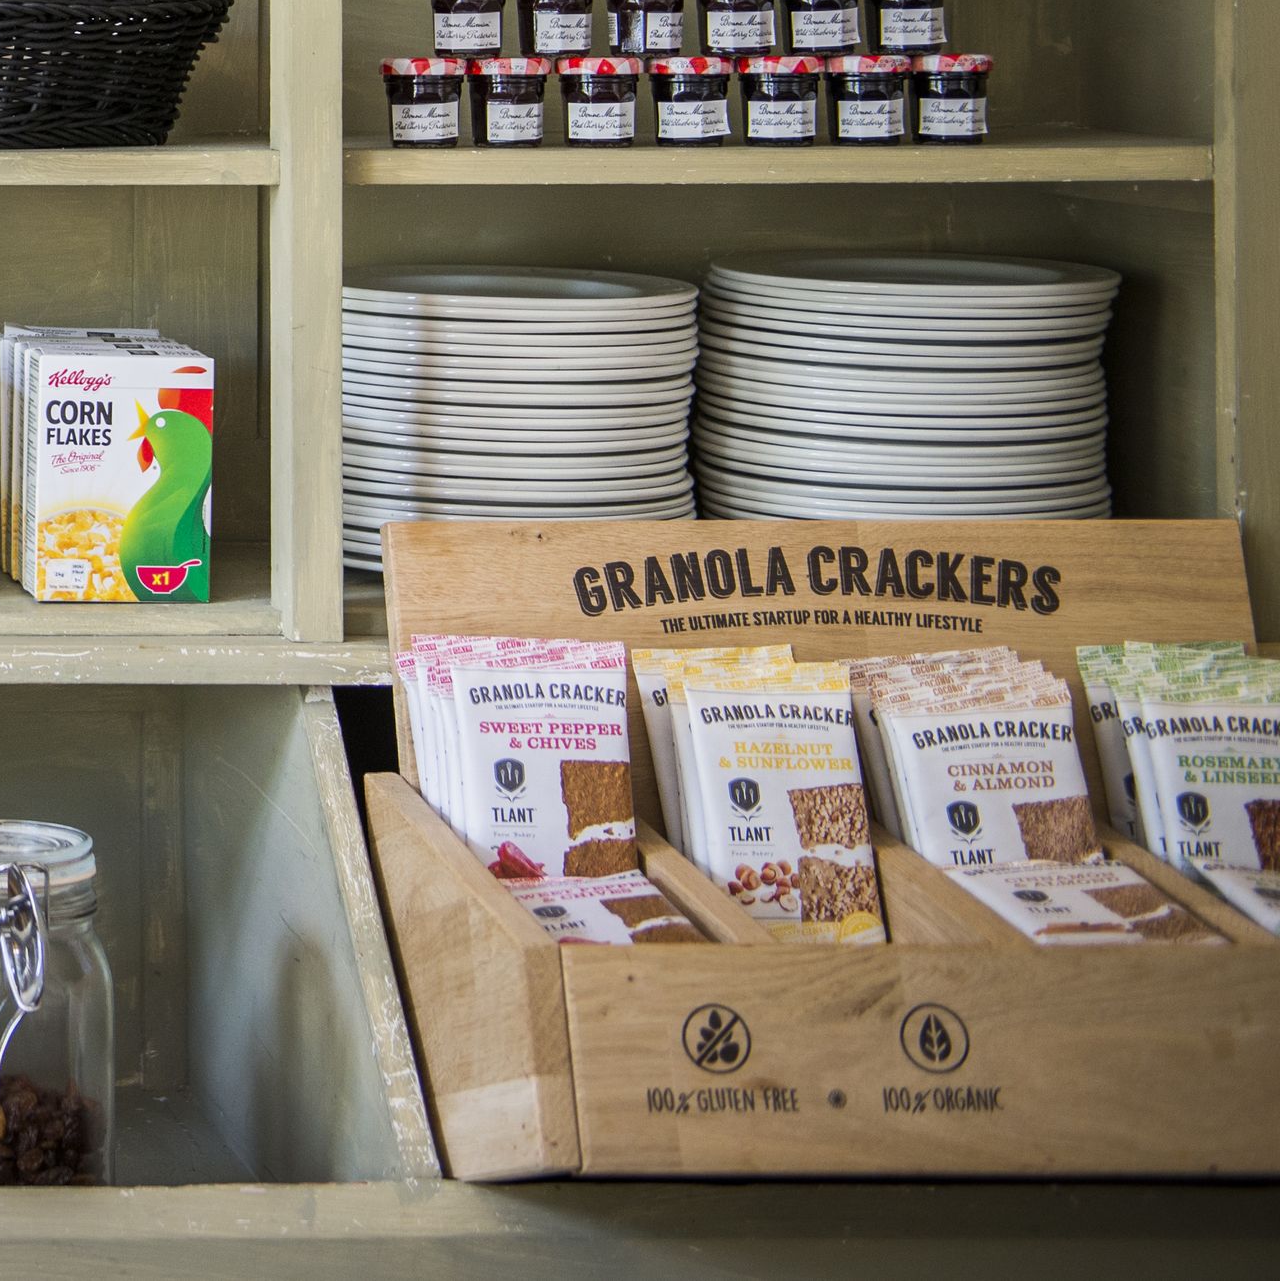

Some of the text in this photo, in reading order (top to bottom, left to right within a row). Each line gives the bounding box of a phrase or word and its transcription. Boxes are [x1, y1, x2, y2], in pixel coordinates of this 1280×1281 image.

[48, 368, 112, 392] Kellogg's
[45, 400, 113, 426] CORN
[46, 428, 112, 446] FLAKES
[51, 450, 105, 466] The Original
[151, 571, 170, 586] x1
[572, 545, 1062, 617] GRANOLA CRACKERS
[660, 610, 983, 634] THE ULTIMATE STARTUP FOR A HEALTHY LIFESTYLE
[469, 682, 545, 705] GRANOLA
[550, 682, 626, 708] CRACKER
[700, 703, 774, 726] GRANOLA
[780, 704, 855, 728] CRACKER
[480, 721, 623, 736] SWEET PEPPER
[912, 721, 990, 750] GRANOLA
[993, 720, 1073, 743] CRACKER
[1146, 715, 1223, 740] GRANOLA
[509, 738, 597, 751] & CHIVES
[734, 741, 833, 756] HAZELNUT
[719, 756, 854, 771] & SUNFLOWER
[947, 760, 1054, 777] CINNAMON
[1177, 755, 1280, 768] ROSEMARY
[953, 775, 1055, 791] & ALMOND
[1184, 770, 1280, 785] & LINSEED
[491, 806, 534, 823] TLANT
[728, 826, 772, 842] TLANT
[950, 848, 994, 866] TLANT
[1177, 840, 1220, 857] TLANT
[647, 1086, 1004, 1116] 100% GLUTEN FREE 100% ORGANIC
